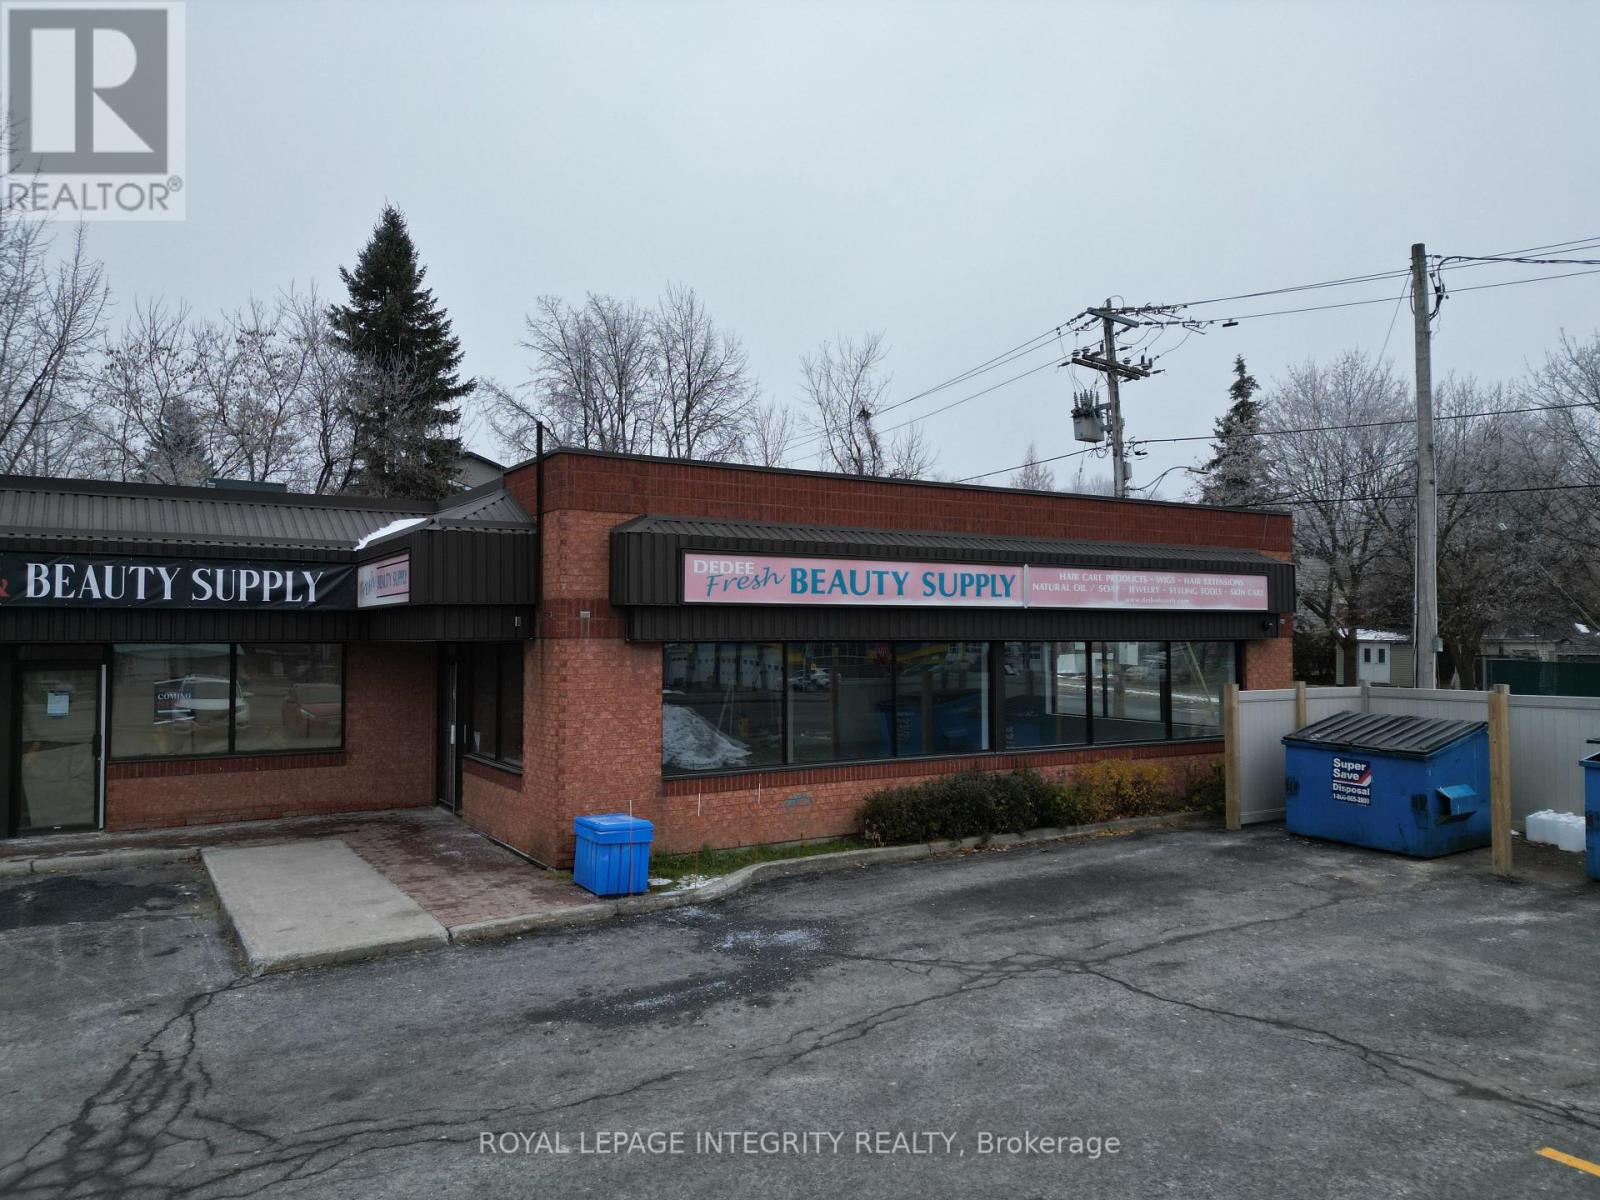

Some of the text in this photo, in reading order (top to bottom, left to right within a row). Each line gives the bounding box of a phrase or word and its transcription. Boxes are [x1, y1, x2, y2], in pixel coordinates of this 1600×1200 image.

[692, 558, 755, 576] DEDEE
[26, 562, 182, 600] BEAUTY
[190, 567, 325, 604] SUPPLY
[705, 566, 1016, 599] Fresh BEAUTY SUPPLY
[1058, 572, 1081, 582] HAIR
[1081, 572, 1105, 583] CARE
[1106, 574, 1147, 583] PRODUCTS
[1156, 575, 1176, 585] WIGS
[1184, 577, 1201, 586] HAIR
[1204, 577, 1244, 587] EXTENSIONS
[1032, 582, 1071, 593] NATURAL
[1073, 583, 1087, 593] OIL
[1129, 584, 1160, 594] JEWELRY
[1168, 587, 1199, 596] STYLING
[1200, 587, 1223, 597] TOOLS
[1230, 588, 1246, 597] SKIN
[1333, 757, 1367, 771] Super
[1332, 767, 1360, 781] Save
[1333, 783, 1370, 796] Disposal
